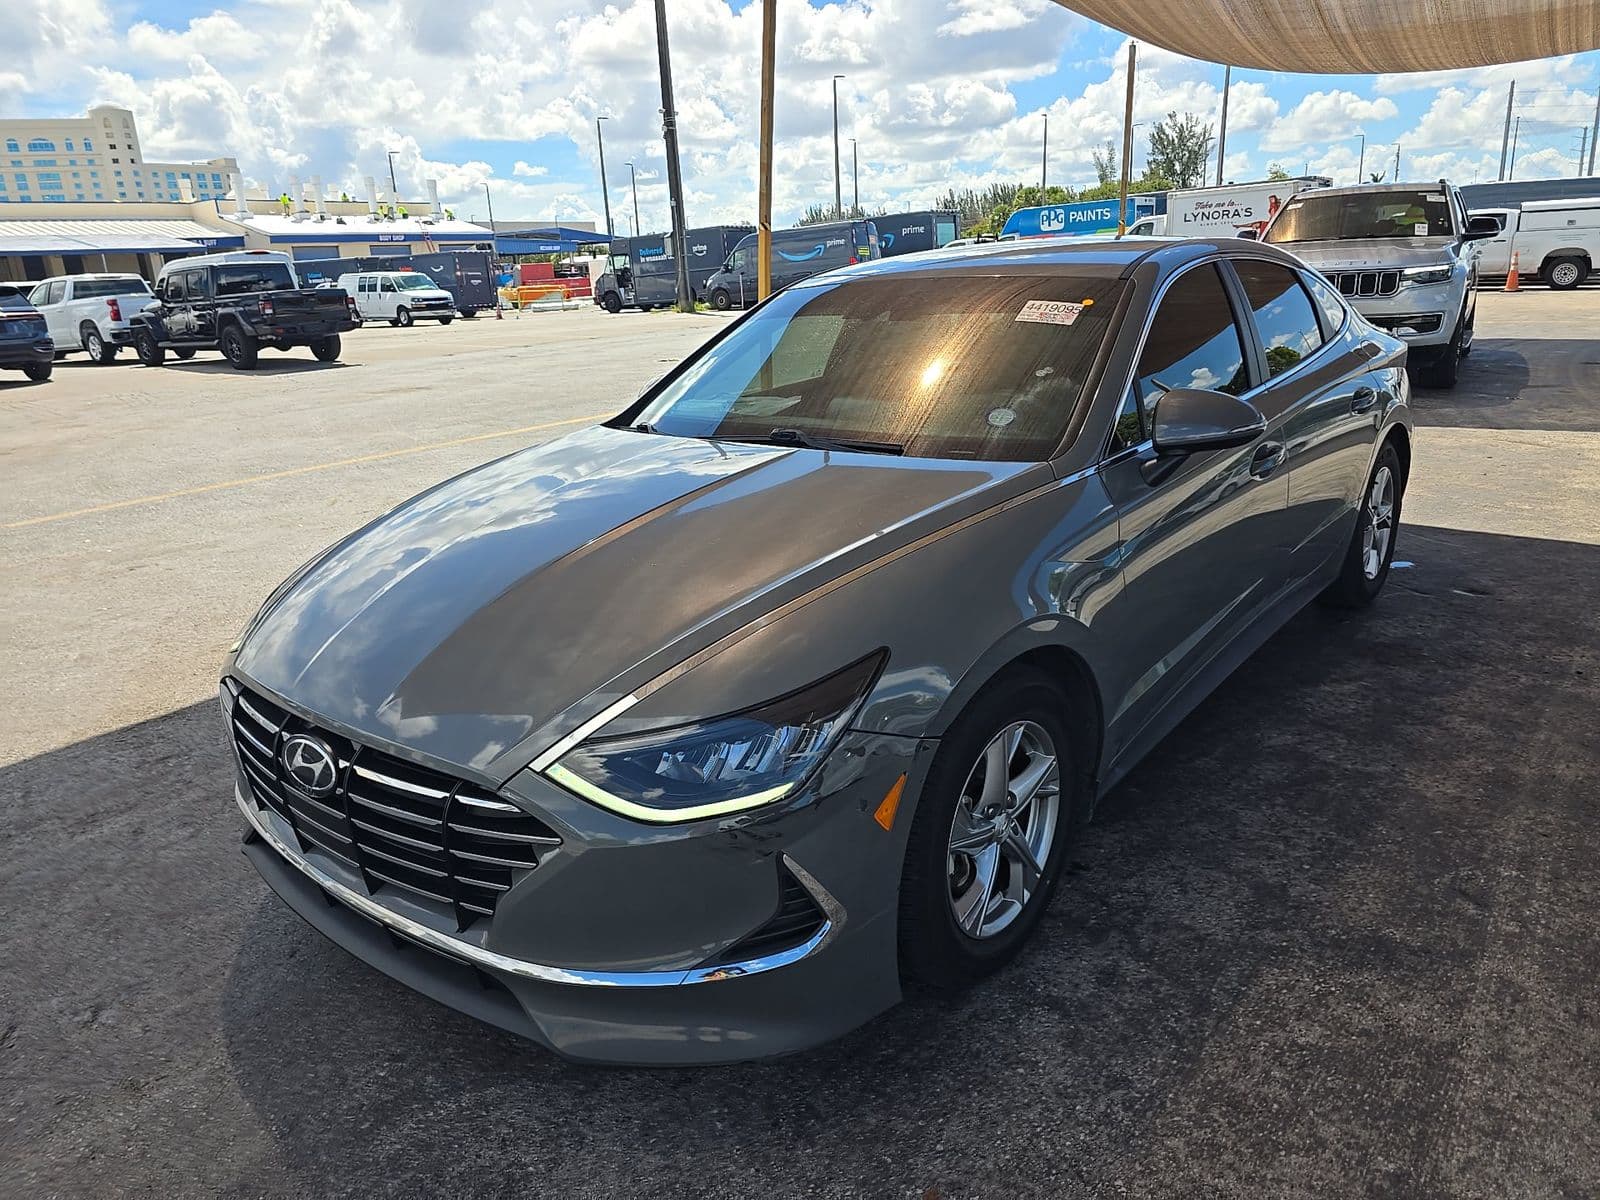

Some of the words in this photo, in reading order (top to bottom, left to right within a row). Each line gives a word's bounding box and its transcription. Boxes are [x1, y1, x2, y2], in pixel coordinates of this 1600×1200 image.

[1041, 209, 1064, 228] PPG
[1069, 208, 1111, 223] PAINTS
[1184, 207, 1253, 223] LYNORA'S
[902, 225, 925, 236] prime
[826, 239, 846, 248] prime
[1026, 303, 1081, 314] 4419095
